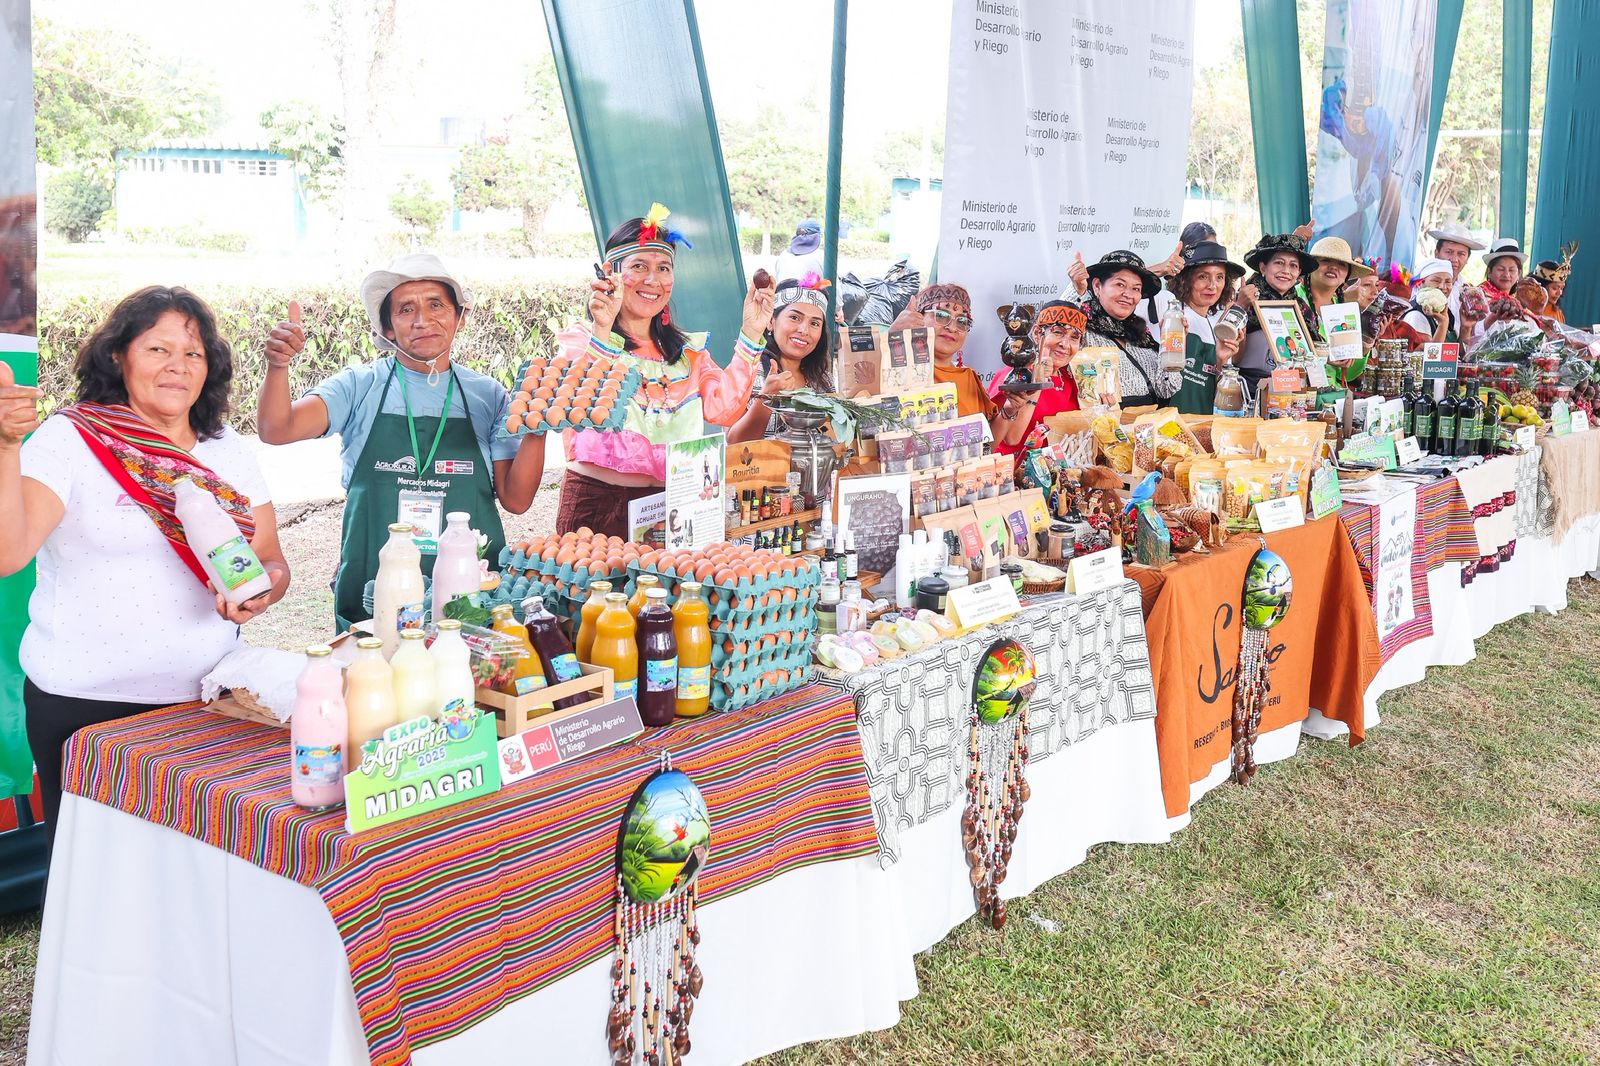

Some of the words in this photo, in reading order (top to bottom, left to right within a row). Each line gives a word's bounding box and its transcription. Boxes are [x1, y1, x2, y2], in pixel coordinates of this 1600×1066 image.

[975, 18, 1020, 36] Desarrollo
[1105, 25, 1113, 35] de
[974, 40, 980, 51] y
[982, 38, 1009, 55] Riego
[1105, 42, 1128, 55] Agrario
[1153, 66, 1170, 80] Riego
[1060, 112, 1069, 123] de
[1107, 117, 1138, 131] Ministerio
[1138, 121, 1147, 131] de
[1105, 133, 1137, 147] Desarrollo
[1137, 137, 1160, 149] Agrario
[1104, 151, 1109, 162] y
[1108, 150, 1127, 164] Riego
[962, 199, 1006, 214] Ministerio
[1007, 202, 1018, 214] de
[1087, 205, 1096, 216] de
[1133, 207, 1163, 218] Ministerio
[1163, 208, 1171, 218] de
[960, 218, 1006, 231] Desarrollo
[1006, 219, 1036, 234] Agrario
[1087, 222, 1110, 235] Agrario
[1131, 222, 1161, 233] Desarrollo
[959, 238, 965, 250] y
[966, 236, 993, 251] Riego
[1056, 240, 1061, 251] y
[1129, 241, 1133, 250] y
[1133, 239, 1150, 250] Riego
[1013, 284, 1049, 295] Ministerio
[397, 477, 426, 487] Mercados
[427, 480, 450, 488] Midagri
[389, 716, 429, 742] EXPO
[555, 718, 589, 737] Ministerio
[558, 736, 567, 746] de
[567, 723, 601, 742] Desarrollo
[602, 715, 625, 731] Agrario
[361, 723, 449, 778] Agraria
[529, 737, 553, 757] PERÚ
[561, 748, 567, 757] y
[567, 741, 586, 753] Riego
[417, 747, 446, 767] 2025
[365, 764, 484, 820] MIDAGRI
